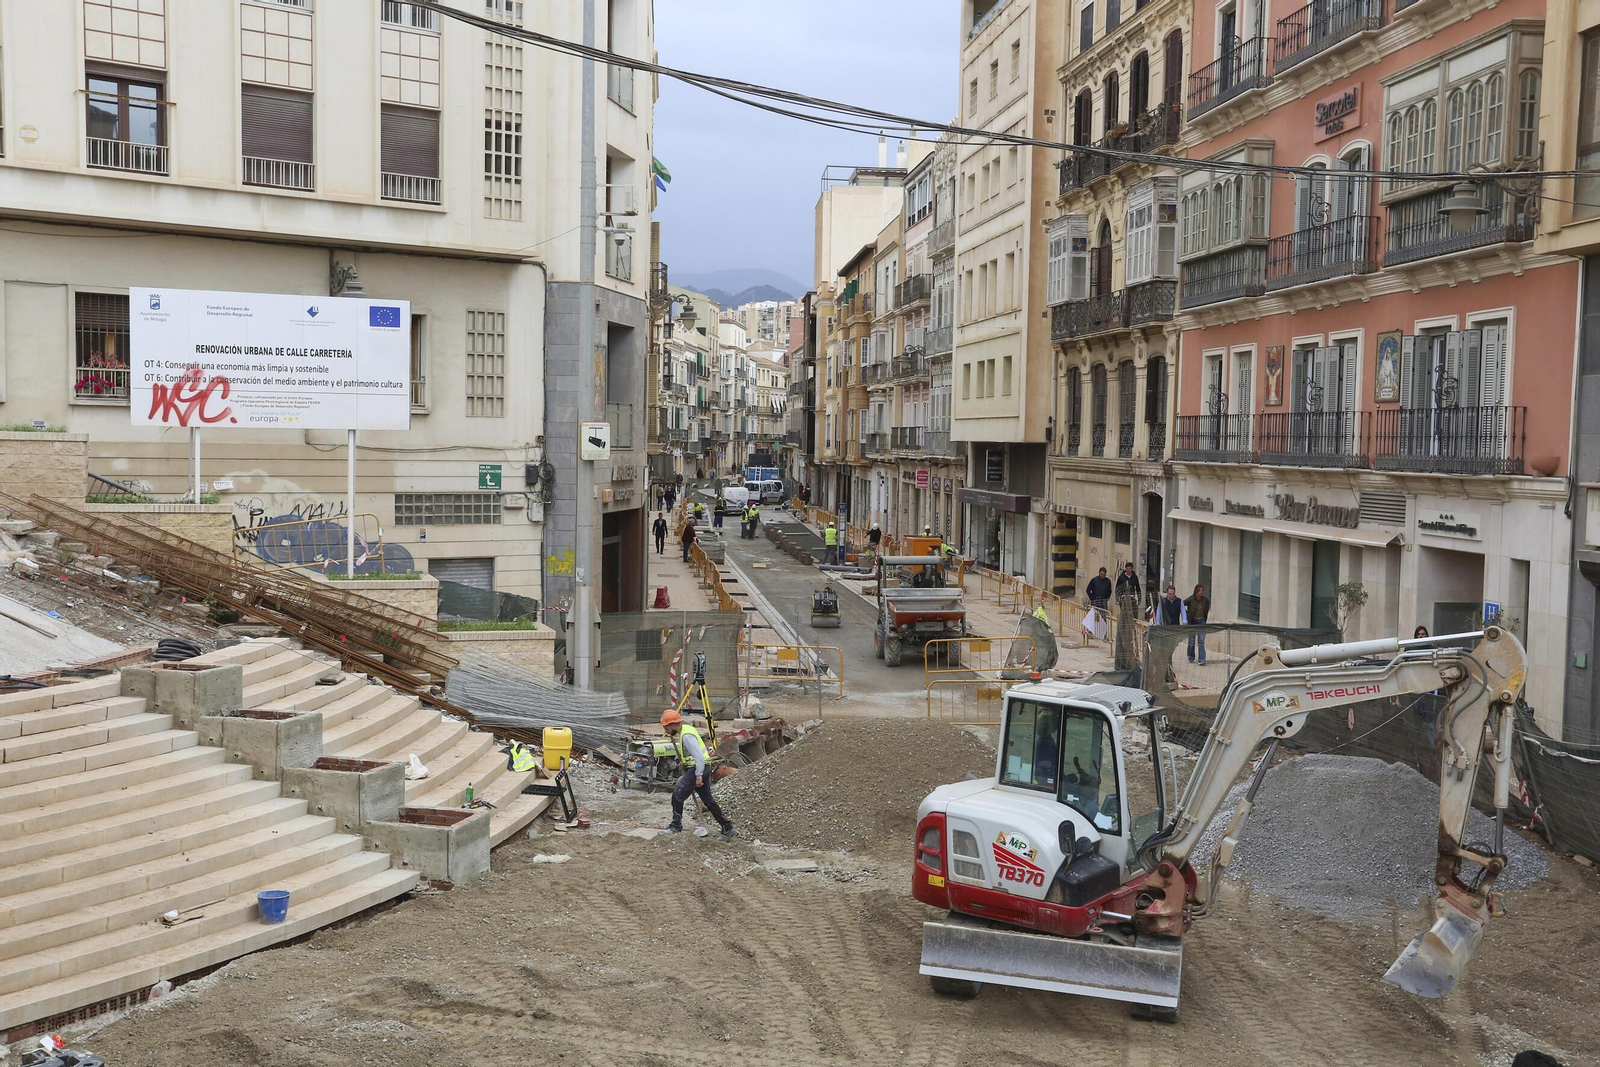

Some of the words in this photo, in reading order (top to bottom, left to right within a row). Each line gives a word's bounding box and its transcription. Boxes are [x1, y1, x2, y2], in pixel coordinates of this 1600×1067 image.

[196, 344, 242, 355] RENOVACIÓN
[244, 346, 273, 356] URBANA
[275, 348, 284, 356] DE
[286, 348, 308, 357] CALLE
[310, 348, 352, 358] CARRETERÍA
[144, 360, 154, 368] OT
[165, 361, 200, 371] Conseguir
[216, 362, 250, 371] economía
[252, 363, 266, 372] más
[268, 364, 288, 374] limpia
[295, 365, 329, 374] sostenible
[156, 374, 163, 382] 6:
[165, 374, 200, 383] Contribuir
[208, 375, 214, 384] la
[215, 376, 261, 385] conservación
[263, 377, 273, 385] del
[275, 378, 296, 386] medio
[298, 378, 329, 387] ambiente
[330, 380, 335, 388] y
[336, 379, 342, 387] el
[344, 379, 379, 388] patrimonio
[380, 380, 403, 389] cultura
[1488, 605, 1495, 619] H
[1306, 685, 1380, 700] TAKEUCHI
[997, 863, 1045, 887] TB370
